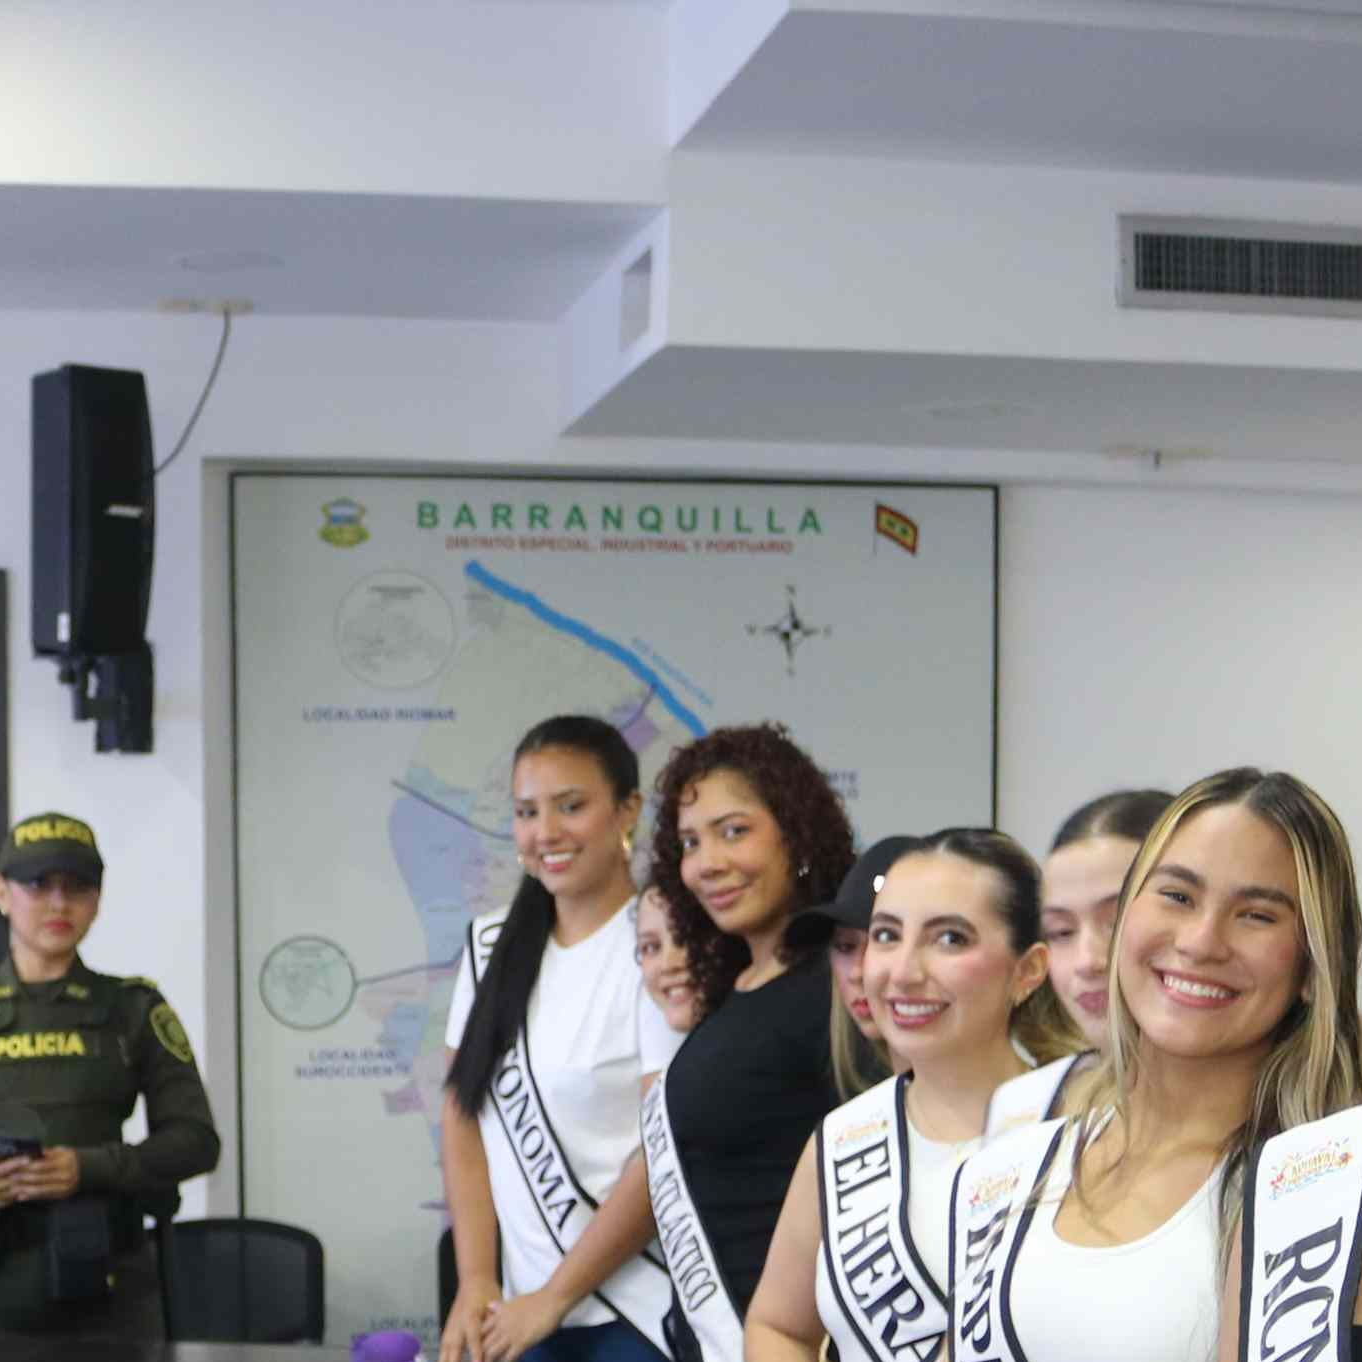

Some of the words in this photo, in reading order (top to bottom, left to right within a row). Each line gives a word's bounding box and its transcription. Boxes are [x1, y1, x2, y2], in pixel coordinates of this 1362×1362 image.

[416, 501, 823, 534] BARRANQUILLA
[445, 535, 513, 551] DISTRITO
[600, 538, 687, 554] INDUSTRIAL
[704, 540, 794, 556] PORTUARIO
[302, 707, 390, 722] LOCALIDAD
[833, 1135, 892, 1215] EL
